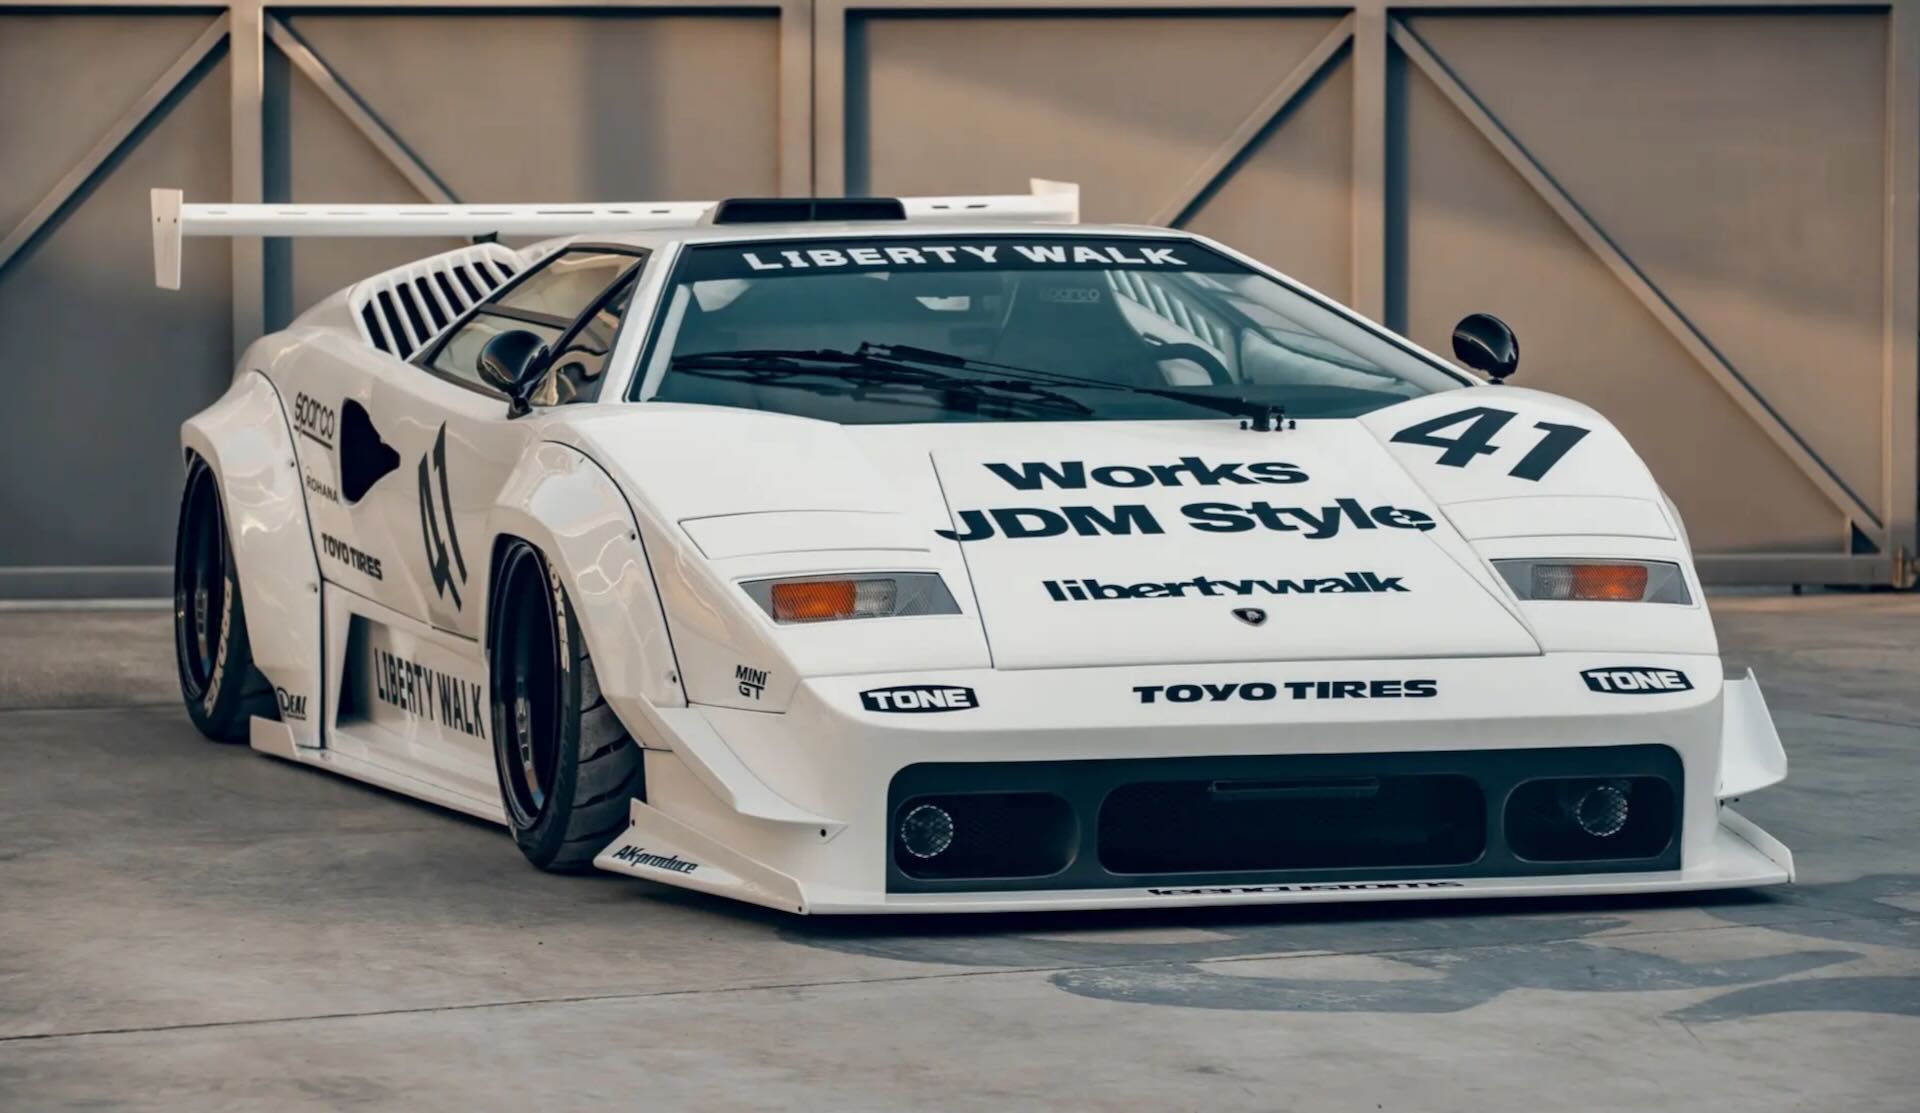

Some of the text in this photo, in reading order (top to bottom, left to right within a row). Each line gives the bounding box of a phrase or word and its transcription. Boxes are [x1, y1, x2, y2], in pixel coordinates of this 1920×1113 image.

[742, 244, 1188, 271] LIBERTY WALK
[294, 391, 336, 440] sparco
[1389, 405, 1592, 483] 41
[305, 474, 340, 503] ROHANA
[983, 457, 1310, 491] Works
[417, 420, 468, 613] 41
[935, 498, 1437, 543] JDM Style
[321, 532, 383, 580] TOYO TIRES
[1042, 571, 1411, 602] libertywalk
[735, 664, 768, 686] MINI
[738, 681, 765, 700] GT
[1587, 671, 1687, 690] TONE
[374, 647, 486, 740] LIBERTY WALK
[867, 689, 971, 710] TONE
[1132, 679, 1438, 704] TOYO TIRES
